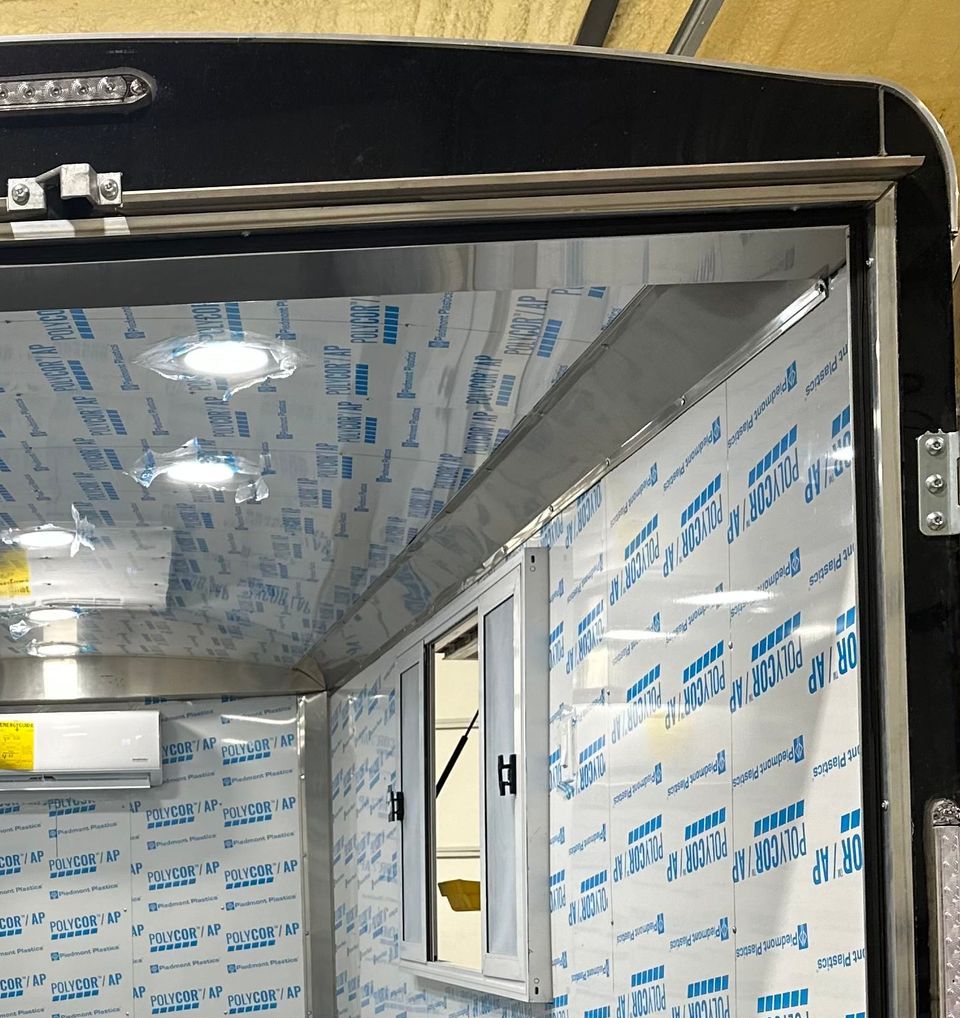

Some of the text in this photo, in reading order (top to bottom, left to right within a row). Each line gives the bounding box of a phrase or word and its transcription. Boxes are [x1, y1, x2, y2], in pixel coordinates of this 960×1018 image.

[813, 751, 847, 778] Plastics
[158, 899, 188, 908] Piedmont
[669, 924, 719, 952] Piedmont Plastics
[736, 931, 796, 961] Piedmont Plastics
[60, 949, 90, 958] Piedmont
